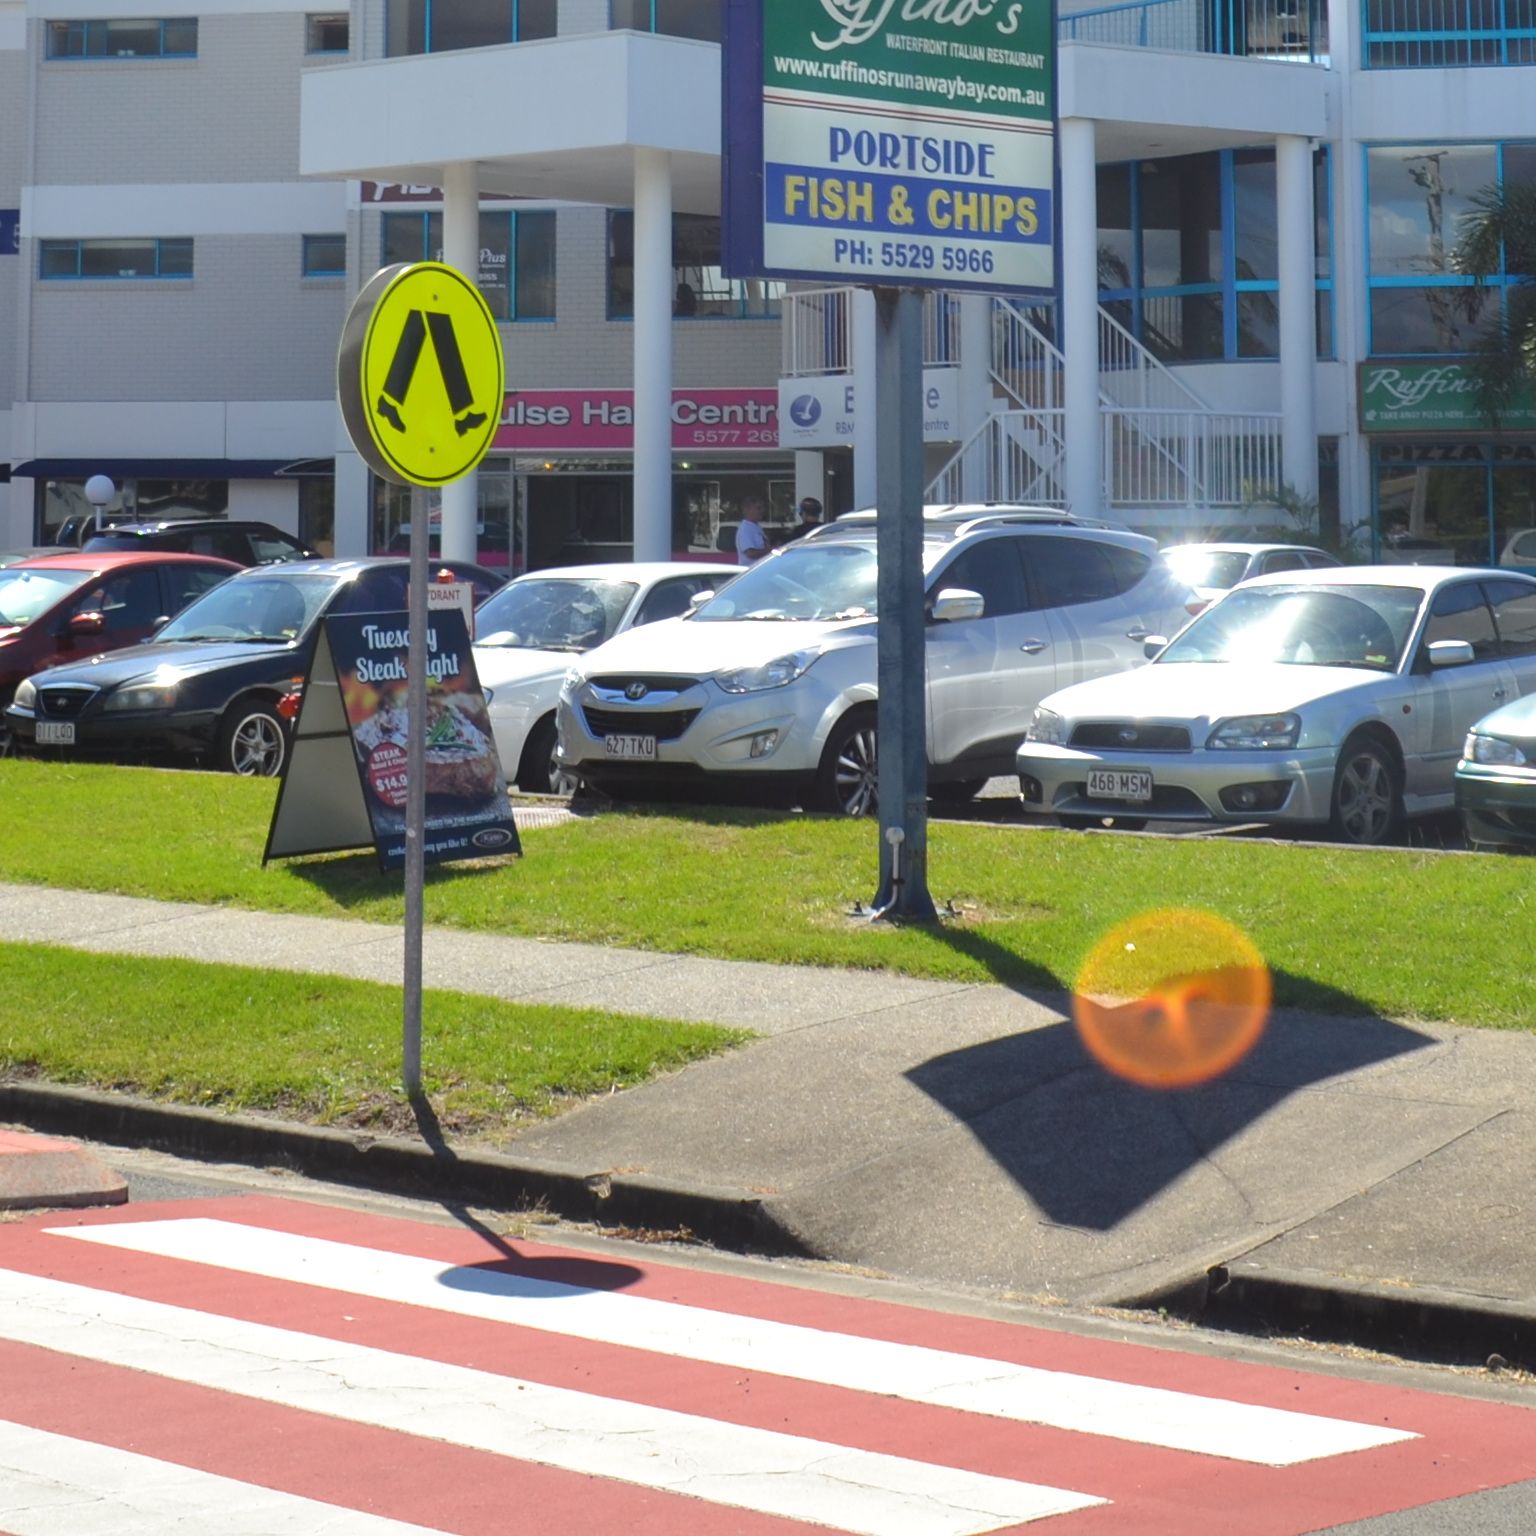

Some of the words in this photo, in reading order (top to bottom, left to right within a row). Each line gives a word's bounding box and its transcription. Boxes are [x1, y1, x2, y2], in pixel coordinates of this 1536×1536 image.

[886, 32, 949, 57] WATERFRONT
[949, 41, 986, 62] ITALIAN
[986, 45, 1045, 70] RESTAURANT
[774, 55, 1046, 106] www.ruffinosrunawaybay.com.au
[829, 126, 996, 178] PORTSIDE
[784, 174, 874, 222] FISH
[888, 187, 915, 226] &
[927, 189, 1039, 236] CHIPS
[835, 238, 873, 266] PH:
[881, 242, 935, 269] 5529
[942, 246, 994, 273] 5966
[1365, 365, 1486, 410] Ruffino
[500, 400, 569, 426] ulse
[583, 400, 633, 425] Ha
[924, 419, 950, 431] entre
[693, 430, 741, 443] 5577
[746, 430, 780, 443] 269
[1380, 444, 1486, 461] PIZZA
[427, 589, 462, 602] DRANT
[362, 624, 438, 653] Tuesy
[356, 656, 408, 683] Steak
[426, 652, 460, 683] ight
[375, 773, 408, 793] $14.9
